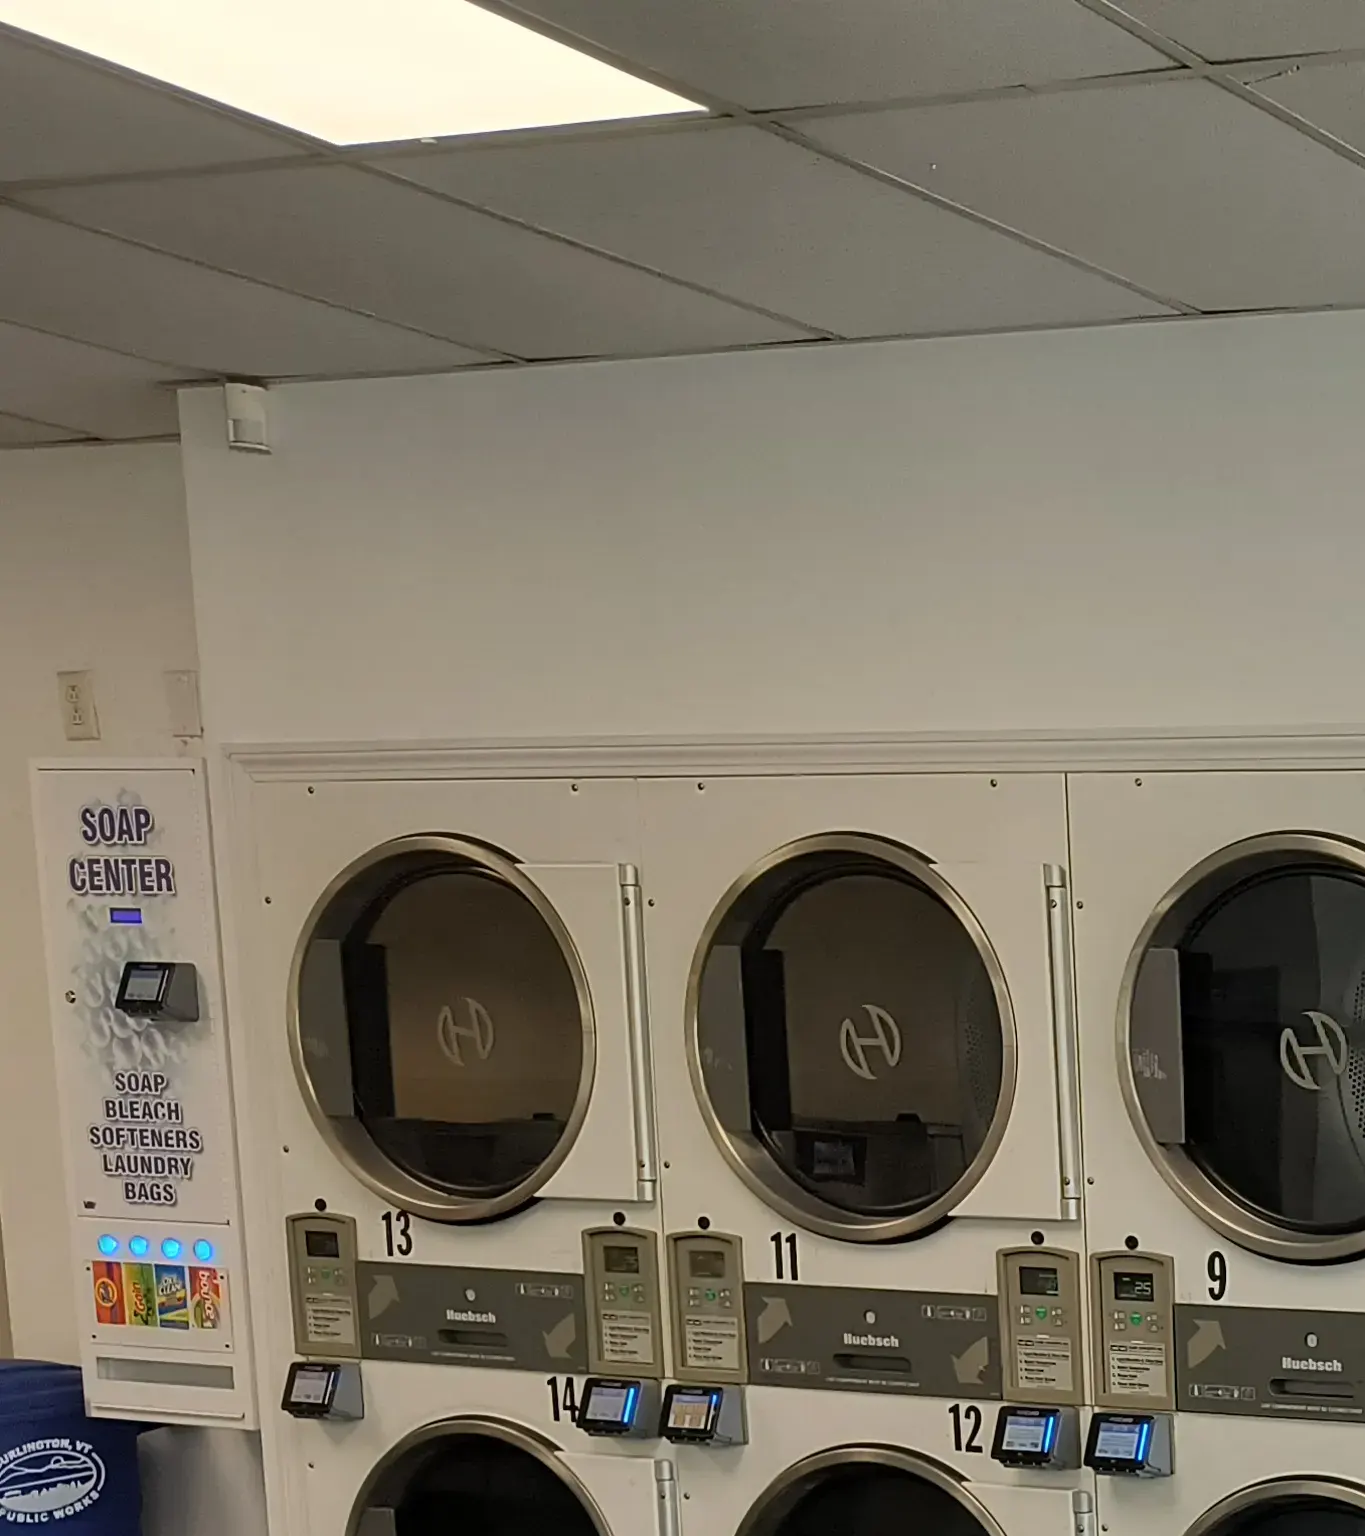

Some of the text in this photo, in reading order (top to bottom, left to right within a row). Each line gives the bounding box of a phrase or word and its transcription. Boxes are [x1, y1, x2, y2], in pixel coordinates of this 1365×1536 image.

[81, 807, 153, 844] SOAP
[69, 858, 174, 893] CENTER
[115, 1072, 166, 1092] SOAP
[104, 1100, 181, 1121] BLEACH
[89, 1127, 200, 1150] SOFTENERS
[102, 1154, 192, 1177] LAUNDRY
[124, 1182, 175, 1203] BAGS
[381, 1210, 413, 1257] 13
[770, 1232, 798, 1280] 11
[1207, 1250, 1227, 1301] 9
[843, 1333, 899, 1348] Huebsch
[1282, 1357, 1342, 1373] Huebsch
[546, 1376, 580, 1423] 14
[948, 1404, 983, 1453] 12
[53, 1490, 99, 1519] WORKS
